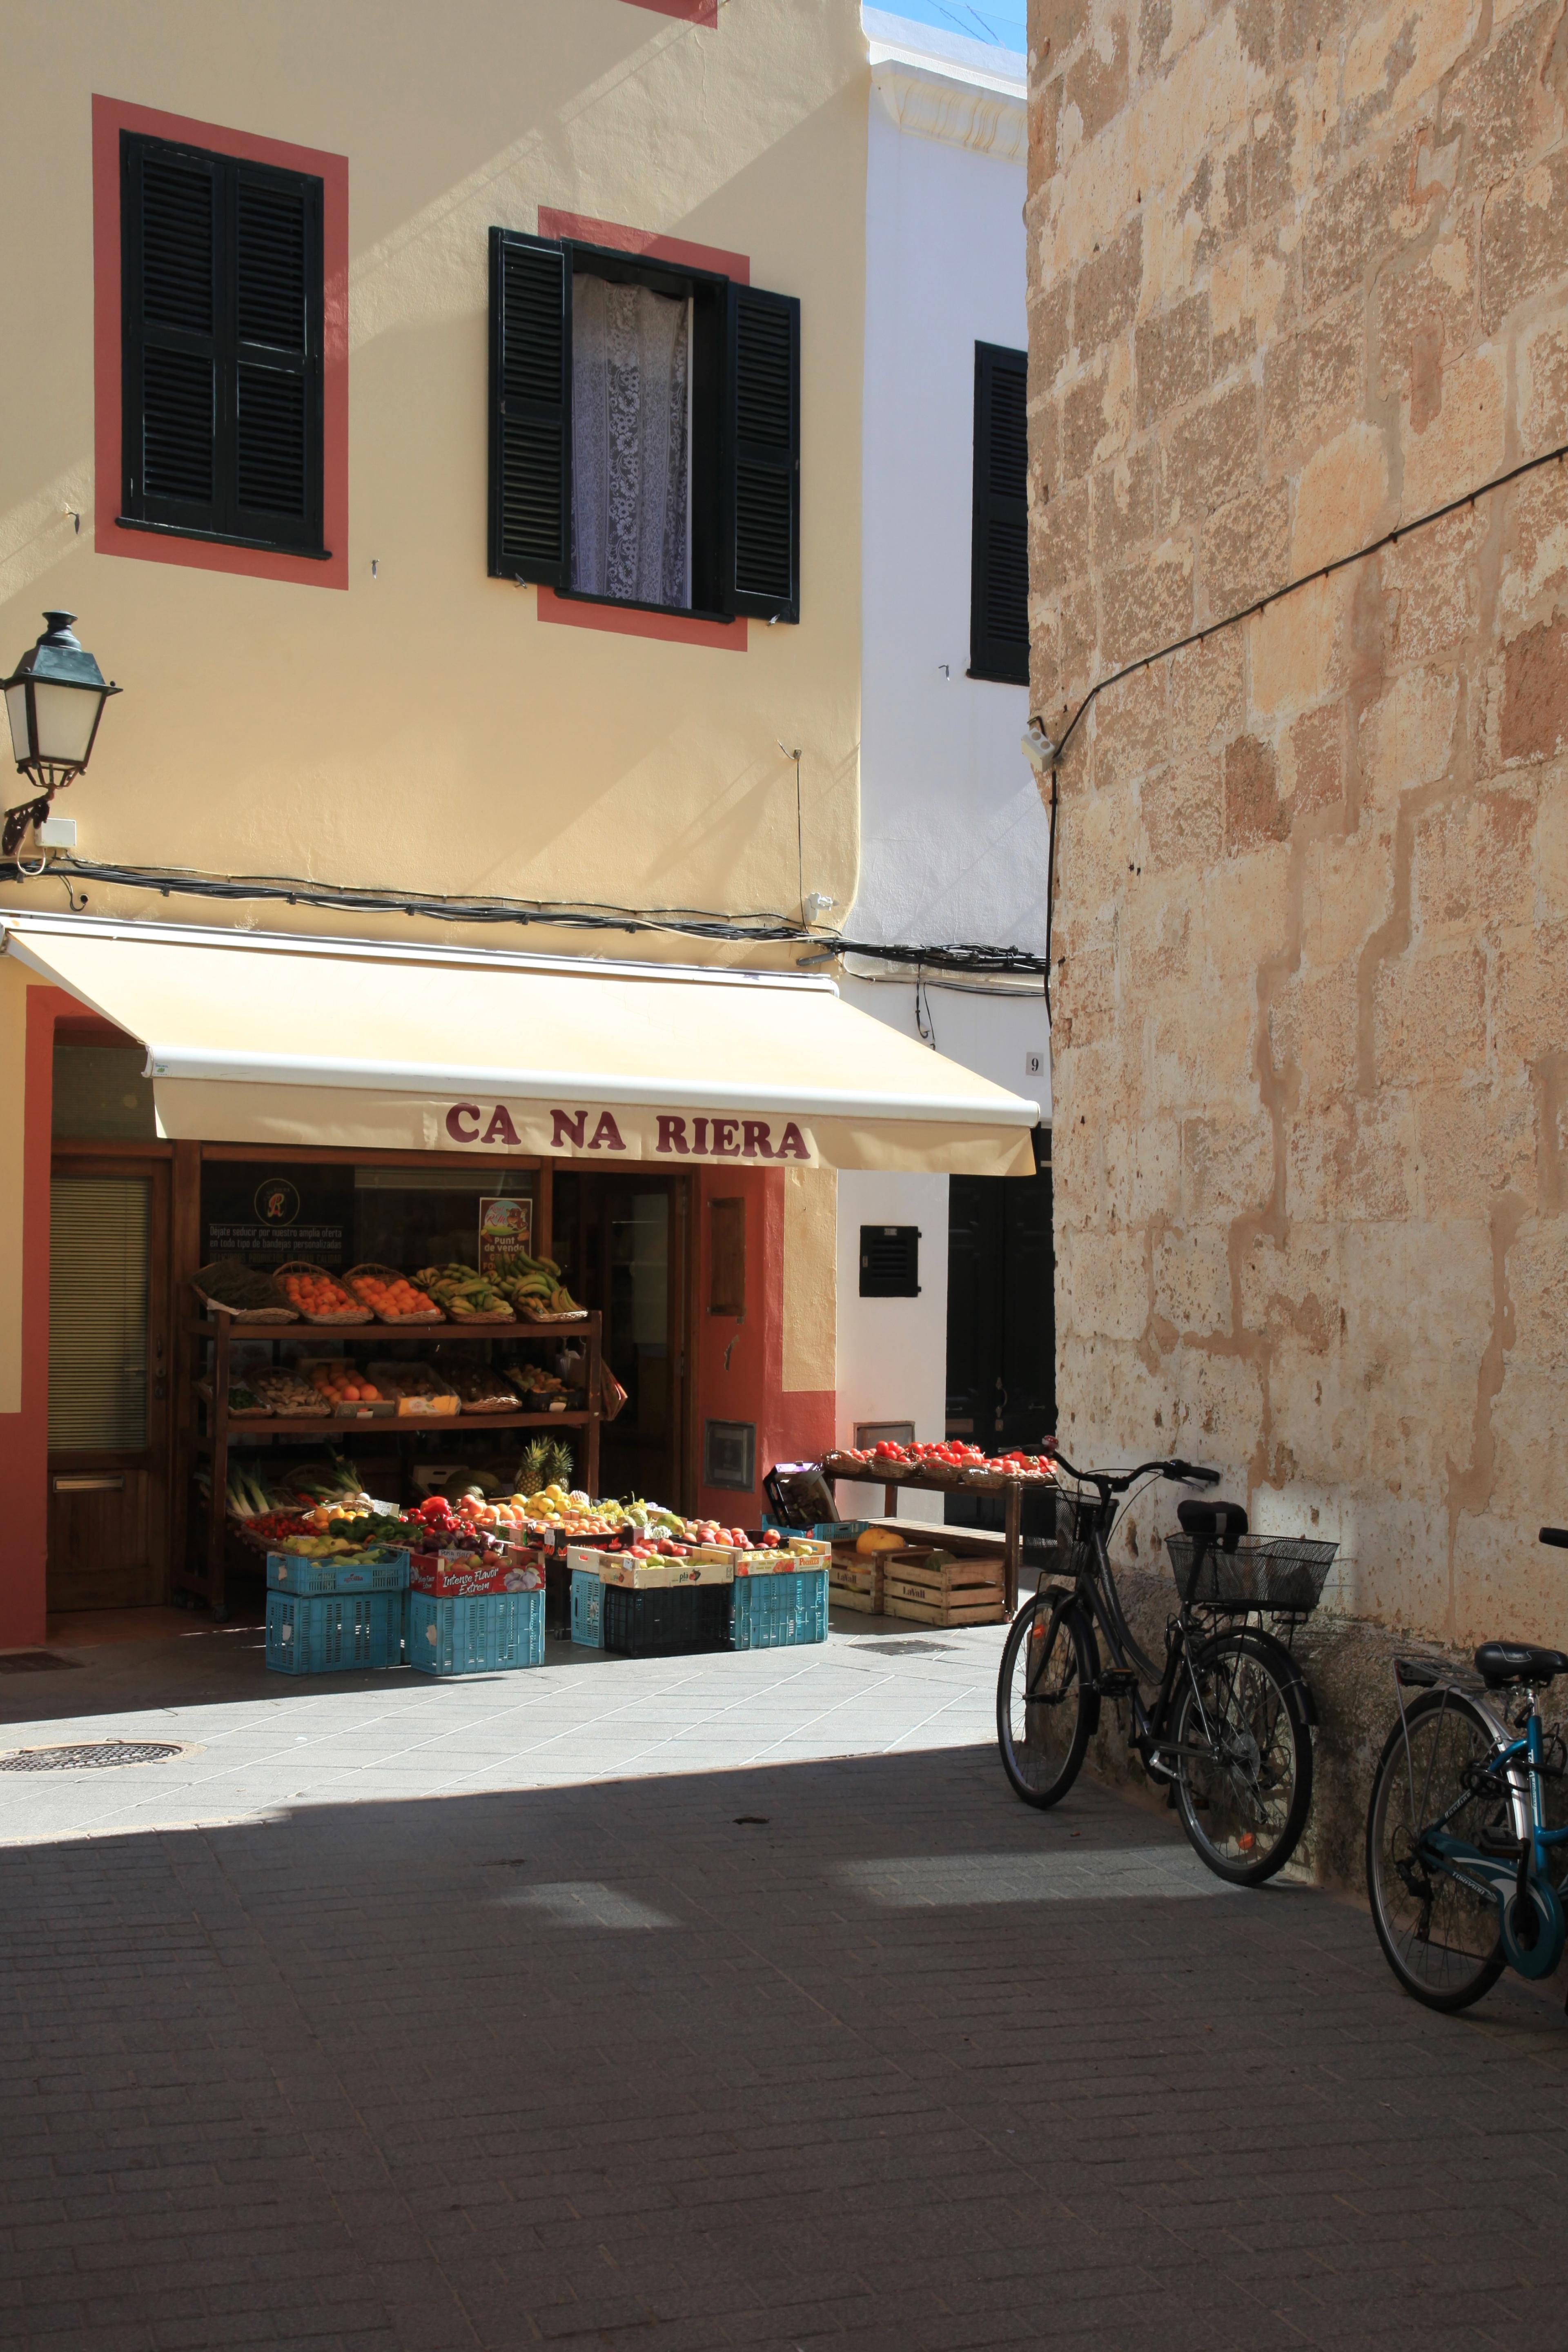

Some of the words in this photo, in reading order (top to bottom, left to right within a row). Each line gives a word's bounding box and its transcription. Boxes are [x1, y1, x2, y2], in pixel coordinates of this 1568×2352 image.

[1031, 1058, 1039, 1072] 9
[446, 1102, 521, 1145] CA
[550, 1109, 626, 1150] NA
[656, 1115, 811, 1159] RIERA
[233, 1226, 257, 1237] seducir
[259, 1229, 271, 1238] por
[272, 1228, 297, 1237] nuestro
[299, 1228, 320, 1239] amplia
[322, 1228, 342, 1238] oferta
[220, 1238, 235, 1248] todo
[237, 1239, 251, 1250] tipo
[252, 1238, 261, 1248] de
[263, 1238, 291, 1251] bandejas
[294, 1240, 342, 1250] personalizadas
[484, 1244, 495, 1252] de
[497, 1244, 525, 1252] venda
[443, 1574, 472, 1587] Intense
[474, 1568, 499, 1582] Flavor
[459, 1582, 490, 1595] Extrem
[1452, 1871, 1485, 1895] TORPADO
